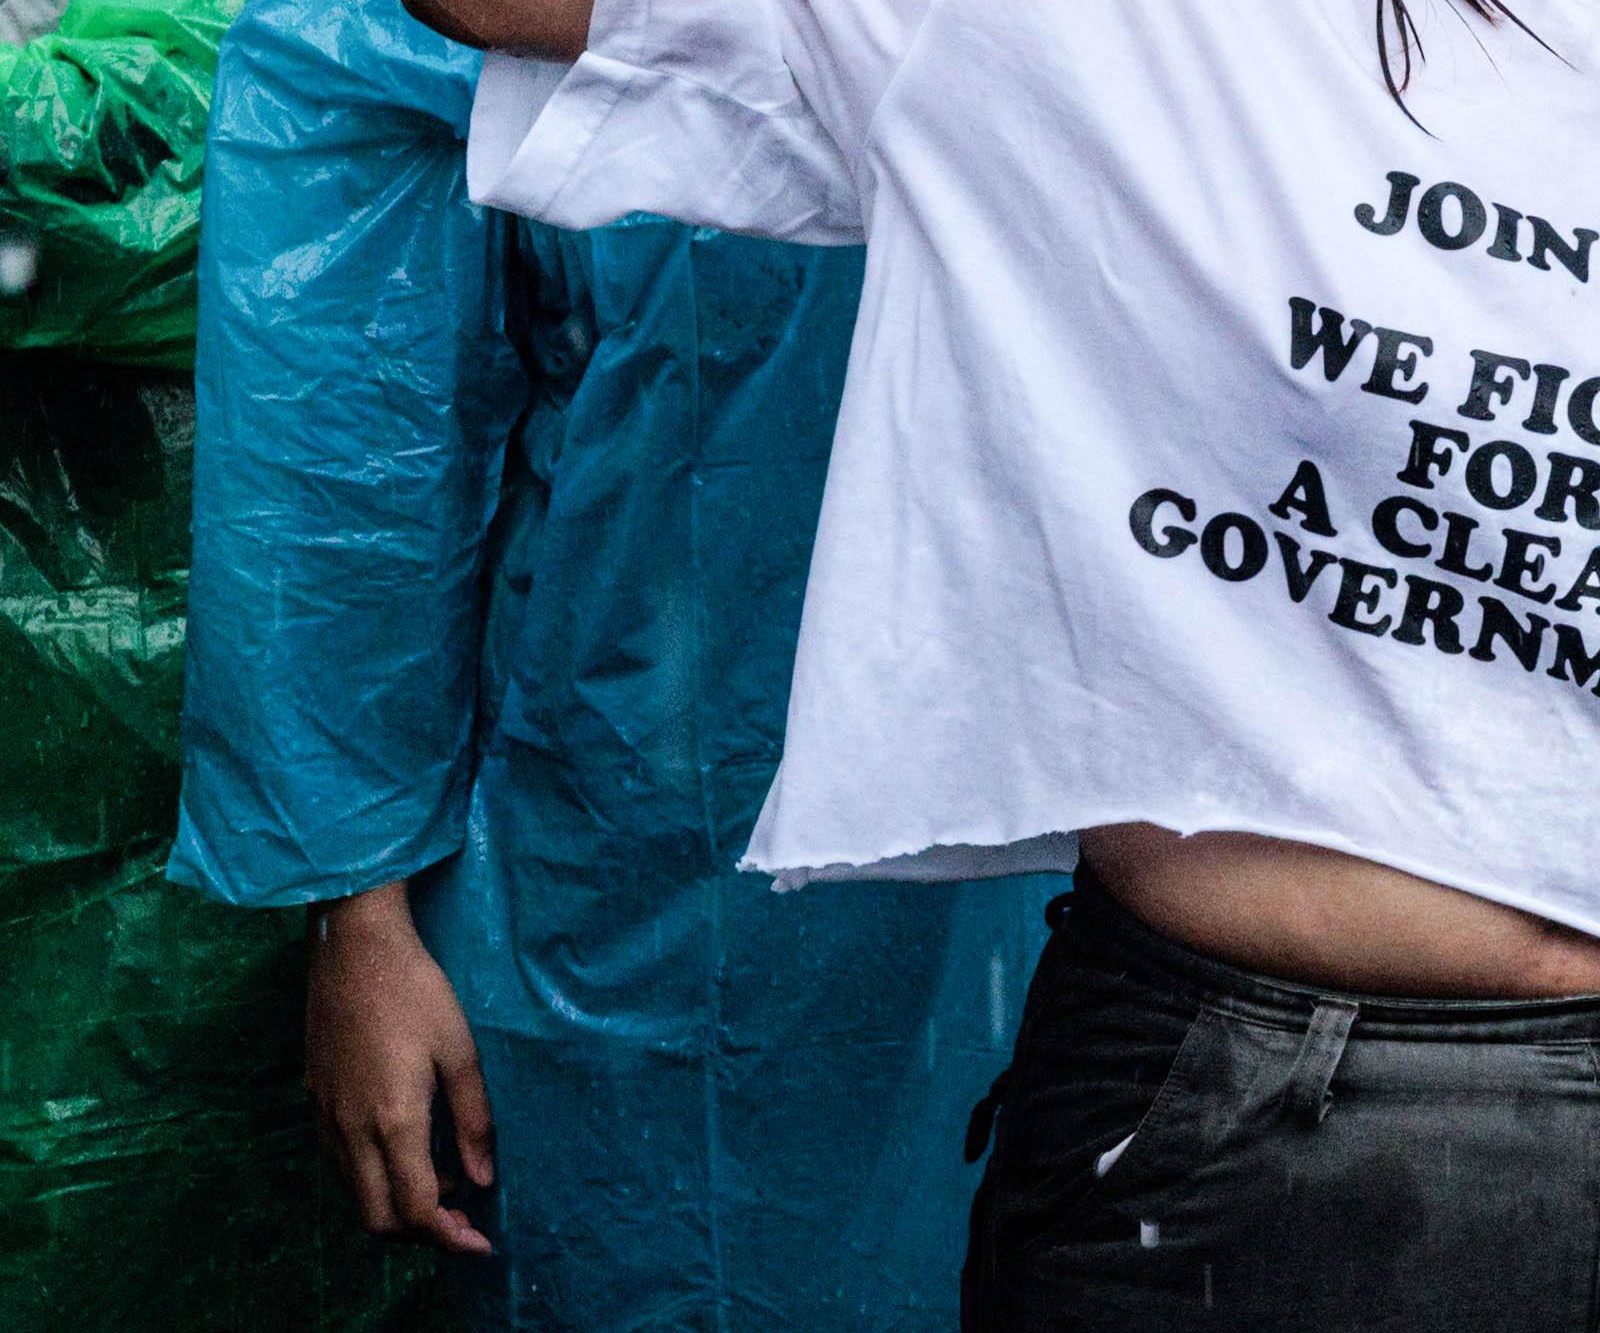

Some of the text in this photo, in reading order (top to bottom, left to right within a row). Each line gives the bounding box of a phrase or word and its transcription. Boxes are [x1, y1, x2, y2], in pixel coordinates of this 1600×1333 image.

[1355, 172, 1599, 282] JOIN
[1289, 297, 1432, 405] WE
[1269, 460, 1337, 537] A
